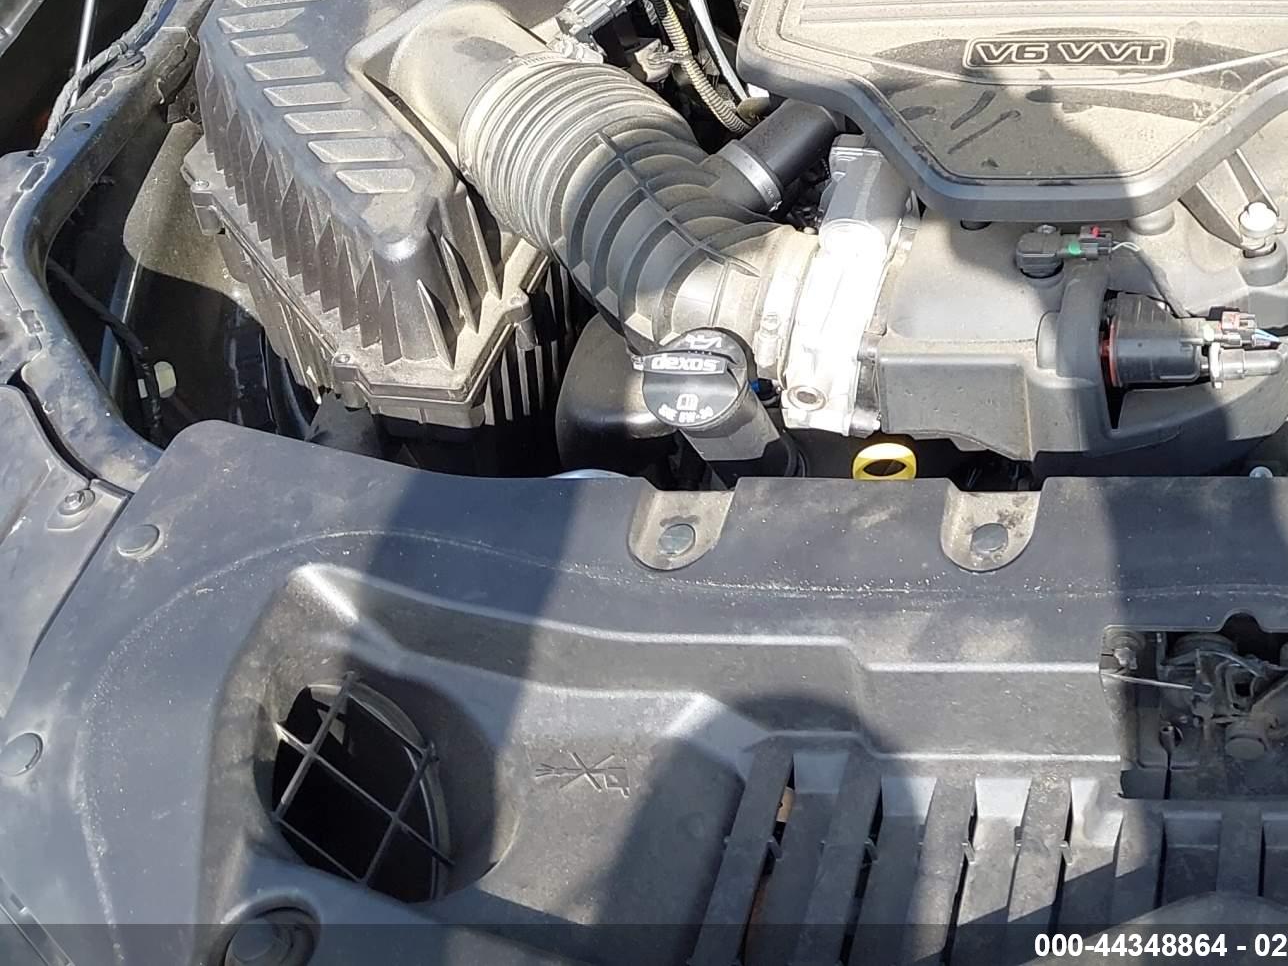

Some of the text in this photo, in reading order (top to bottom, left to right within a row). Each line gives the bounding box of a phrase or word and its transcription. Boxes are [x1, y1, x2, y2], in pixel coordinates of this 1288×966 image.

[976, 41, 1164, 63] V6 VVT
[651, 354, 720, 371] dexos
